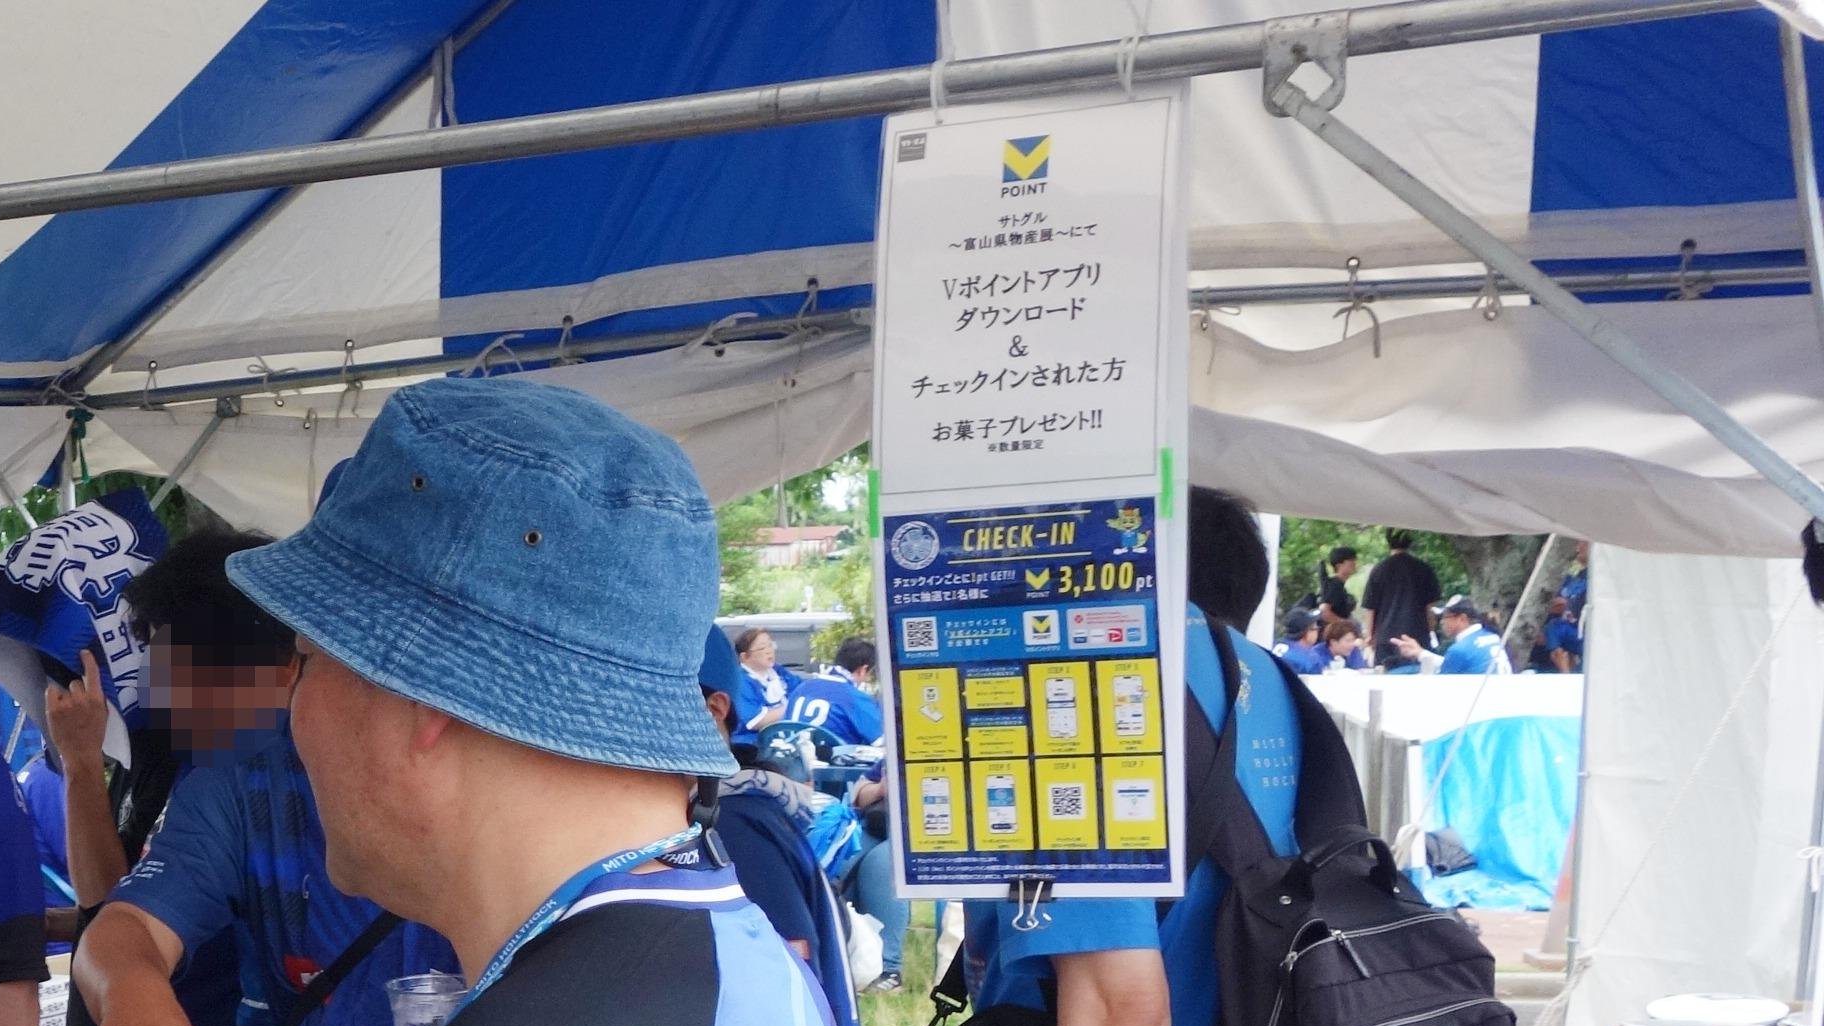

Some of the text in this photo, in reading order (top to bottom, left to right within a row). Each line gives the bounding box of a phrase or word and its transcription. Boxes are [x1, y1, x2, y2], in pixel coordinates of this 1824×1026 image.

[1000, 182, 1047, 198] POINT
[998, 211, 1048, 228] サトグル
[943, 262, 1102, 300] Vポイントアプリ
[954, 297, 1087, 332] ダウンロード
[1008, 335, 1030, 357] &
[911, 357, 1127, 399] チェックインされた方
[962, 521, 1076, 553] CHECK-IN
[1058, 561, 1134, 598] 3,100
[1135, 575, 1154, 592] pt
[602, 850, 639, 874] MITO
[475, 898, 558, 992] MITO HOLLYHOCK
